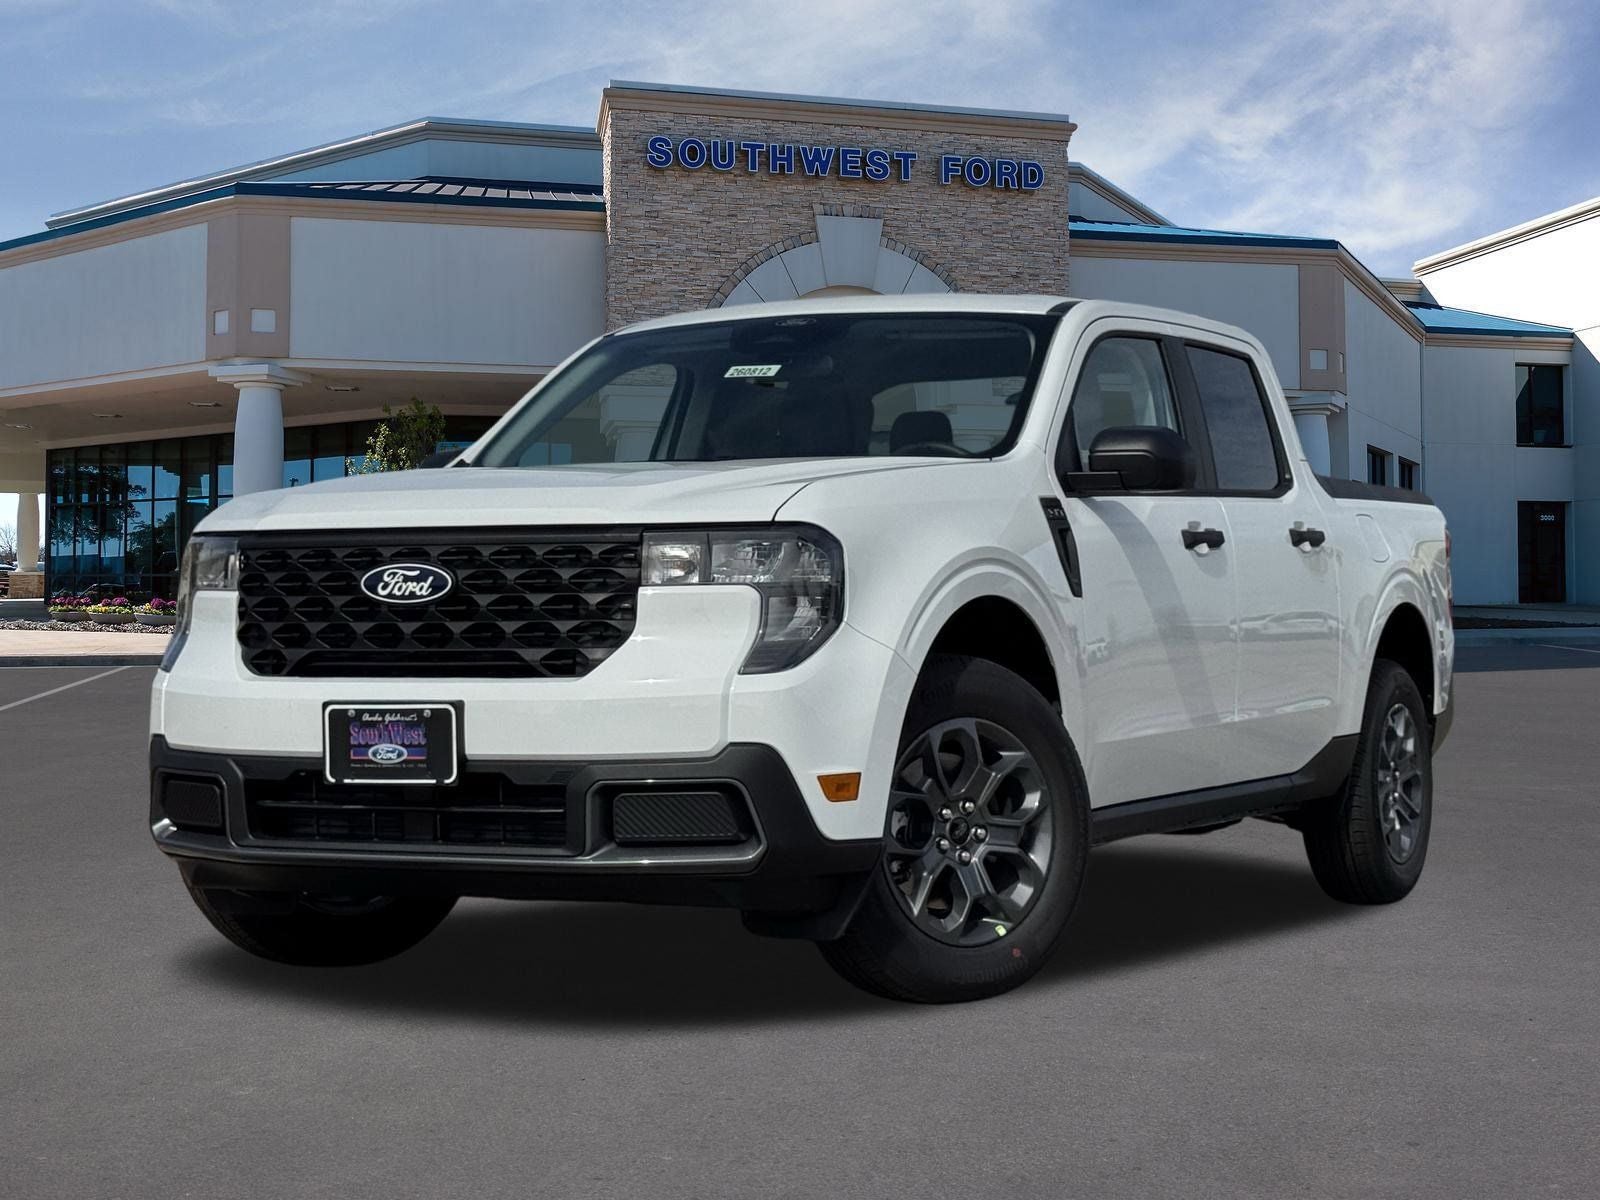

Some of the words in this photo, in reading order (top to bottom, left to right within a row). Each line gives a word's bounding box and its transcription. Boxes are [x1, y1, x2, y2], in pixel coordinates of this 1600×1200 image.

[647, 135, 918, 182] SOUTHWEST
[939, 154, 1046, 191] FORD
[729, 367, 773, 377] 260812
[377, 569, 434, 596] Ford
[375, 746, 399, 760] Ford
